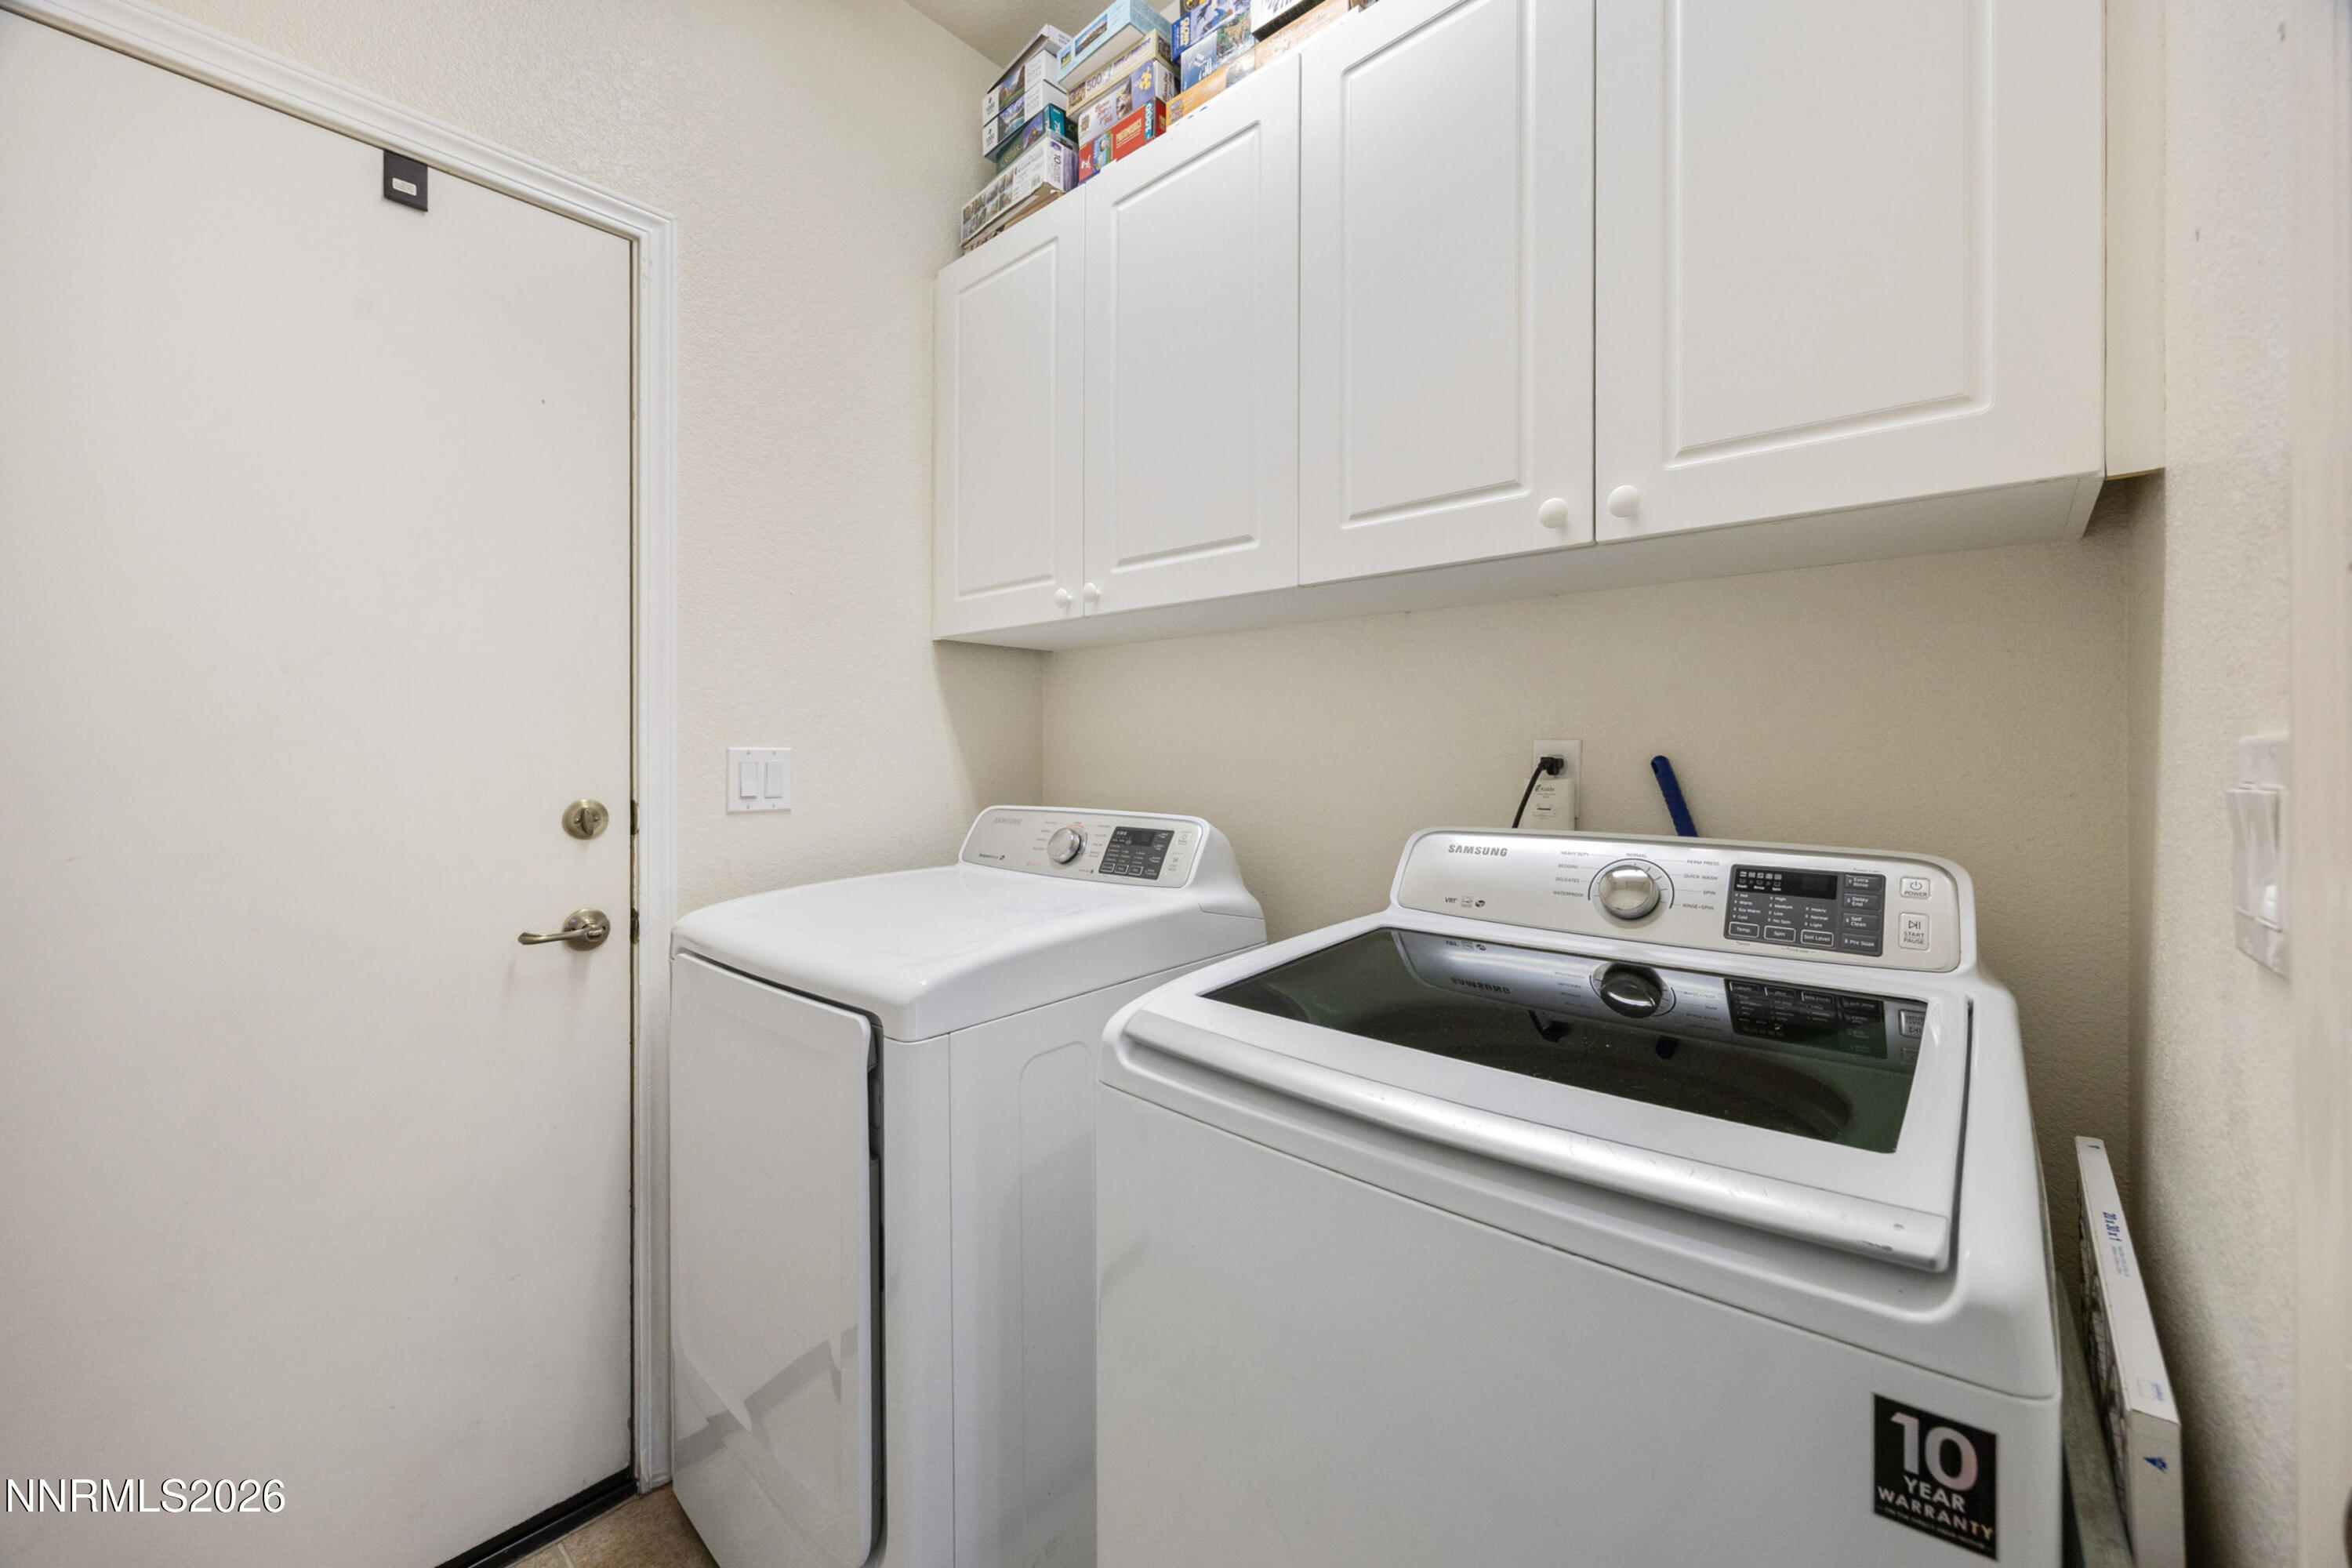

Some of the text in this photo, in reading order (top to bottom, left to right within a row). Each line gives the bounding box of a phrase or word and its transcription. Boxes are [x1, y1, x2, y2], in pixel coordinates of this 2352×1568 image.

[1448, 844, 1508, 857] SAMSUNG
[1890, 1412, 1978, 1492] 10
[1878, 1486, 1993, 1540] WARRANTY
[1904, 1475, 1965, 1513] YEAR
